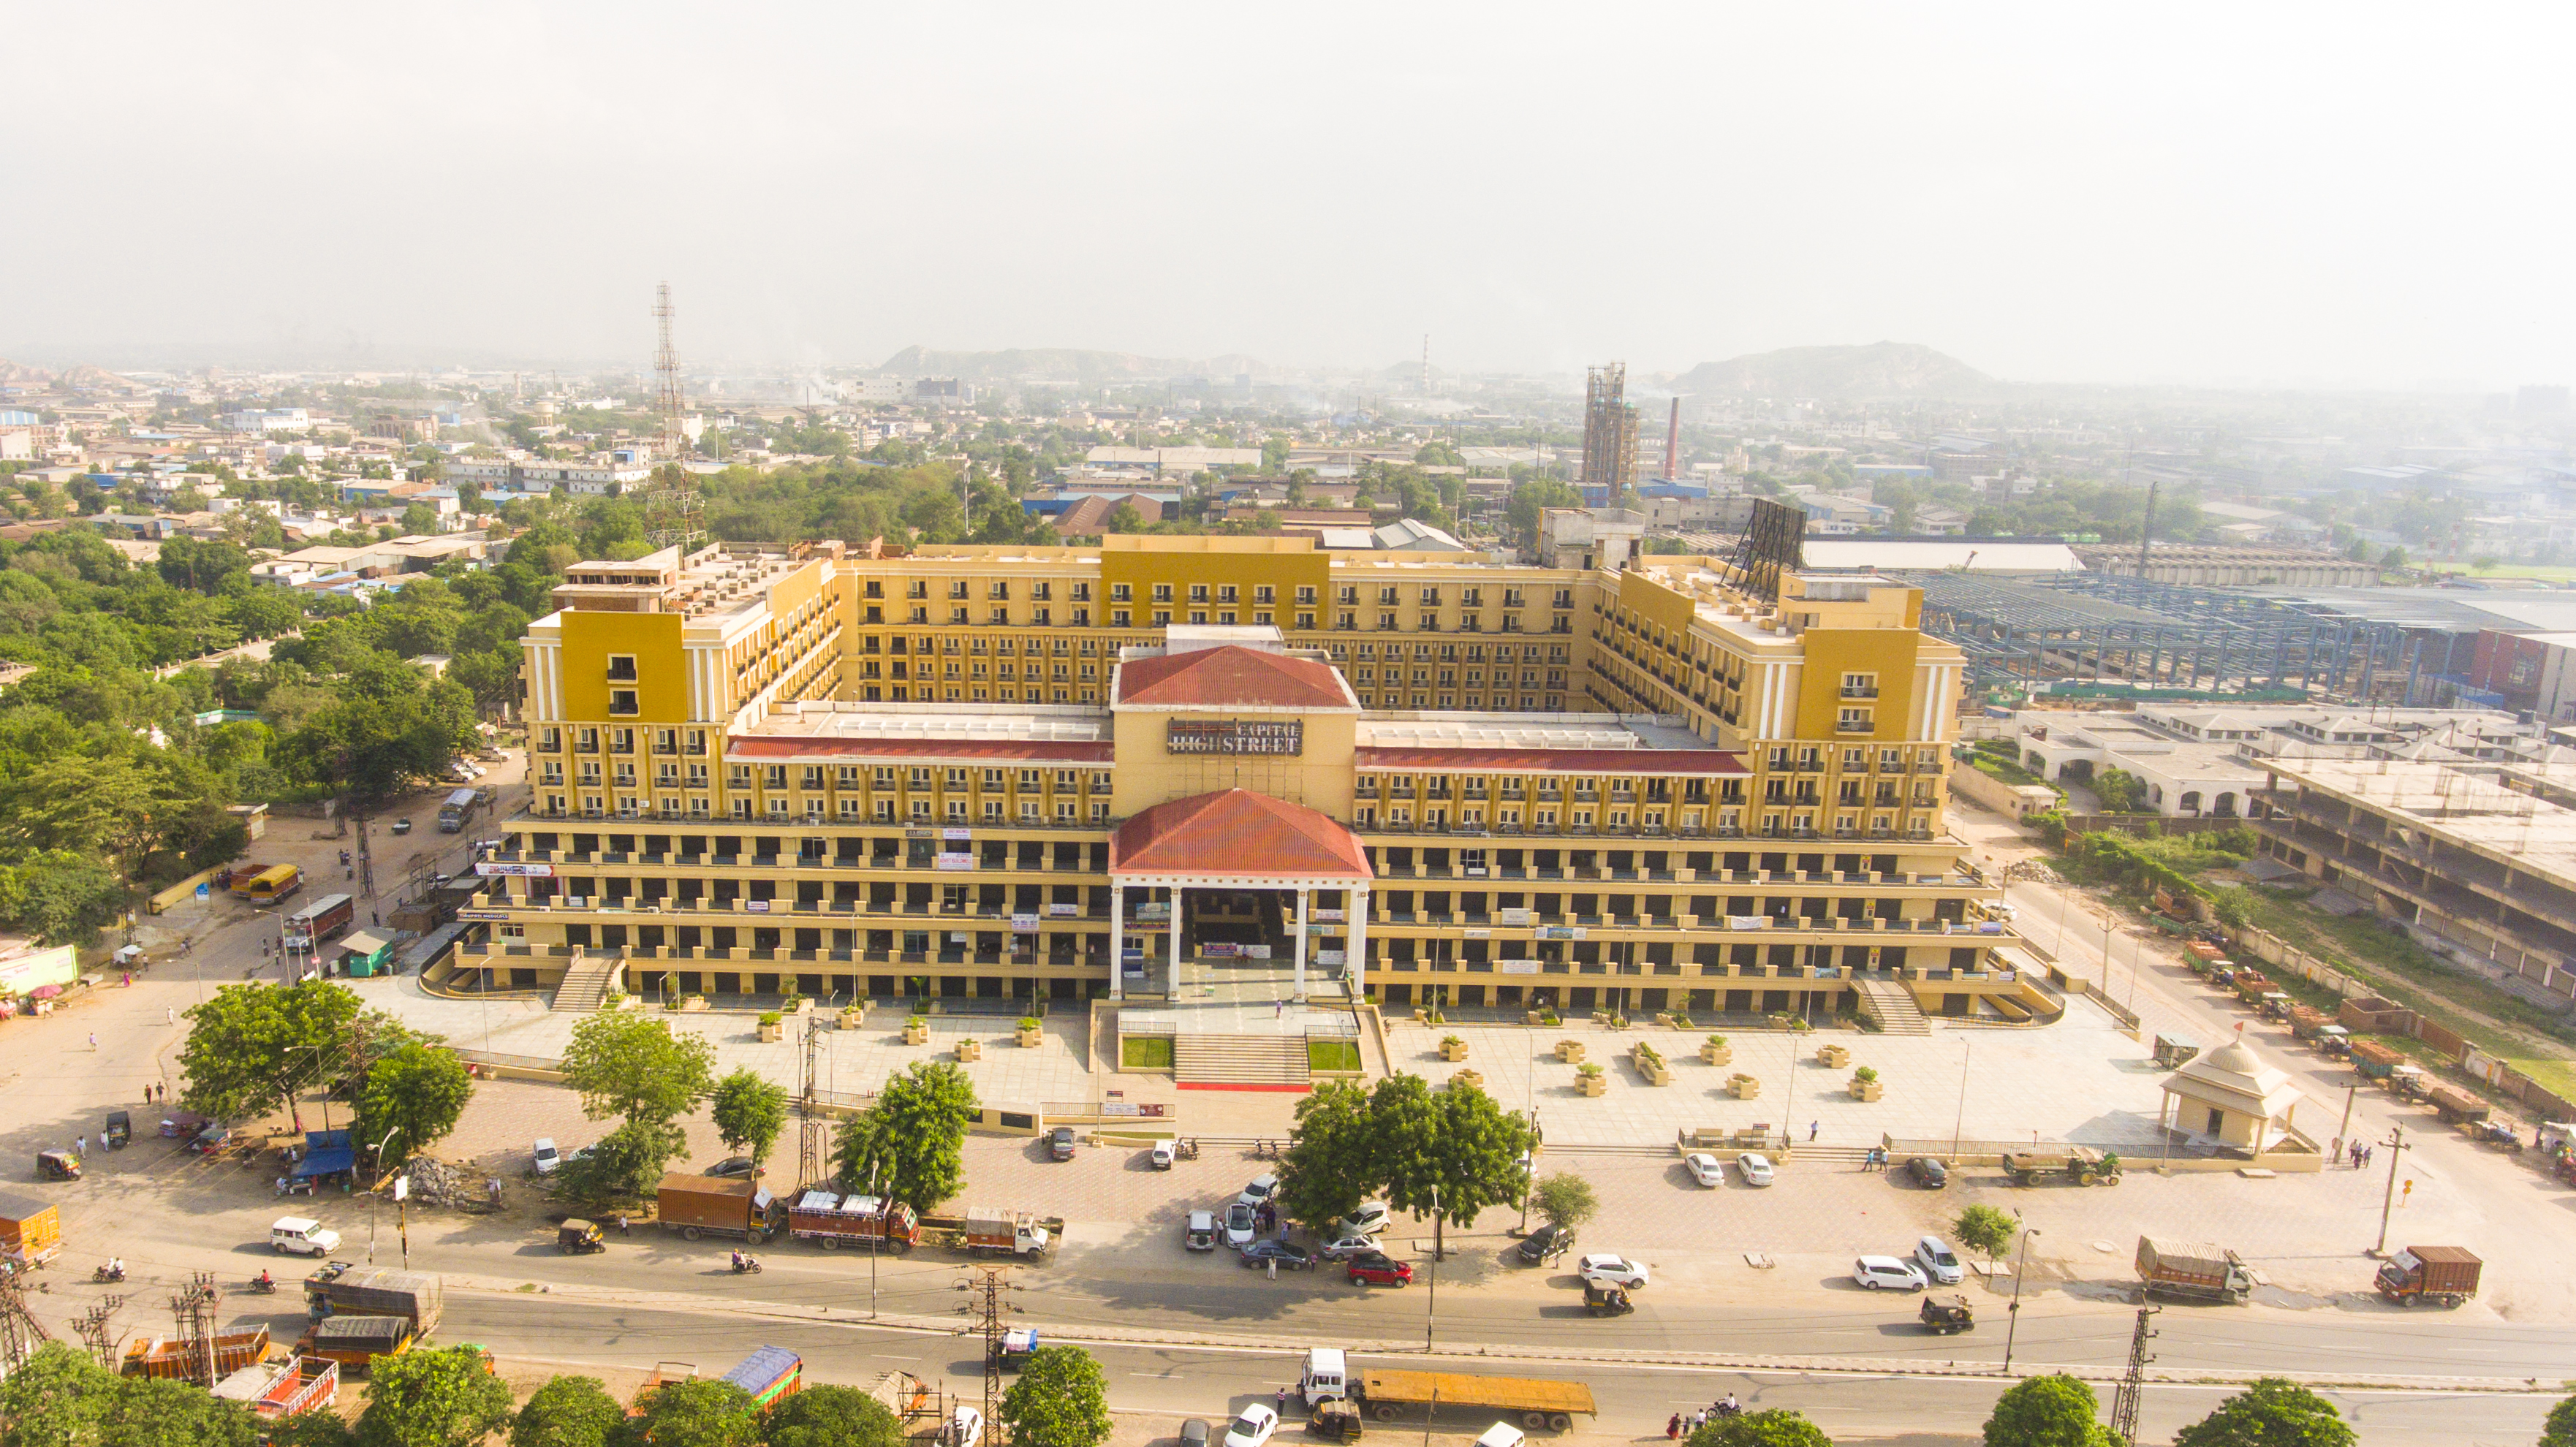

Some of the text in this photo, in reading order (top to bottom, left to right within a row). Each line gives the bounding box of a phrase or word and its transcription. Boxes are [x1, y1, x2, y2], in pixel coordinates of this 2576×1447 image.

[1237, 725, 1299, 737] CAPITAL
[1173, 736, 1298, 753] HIGH STREET
